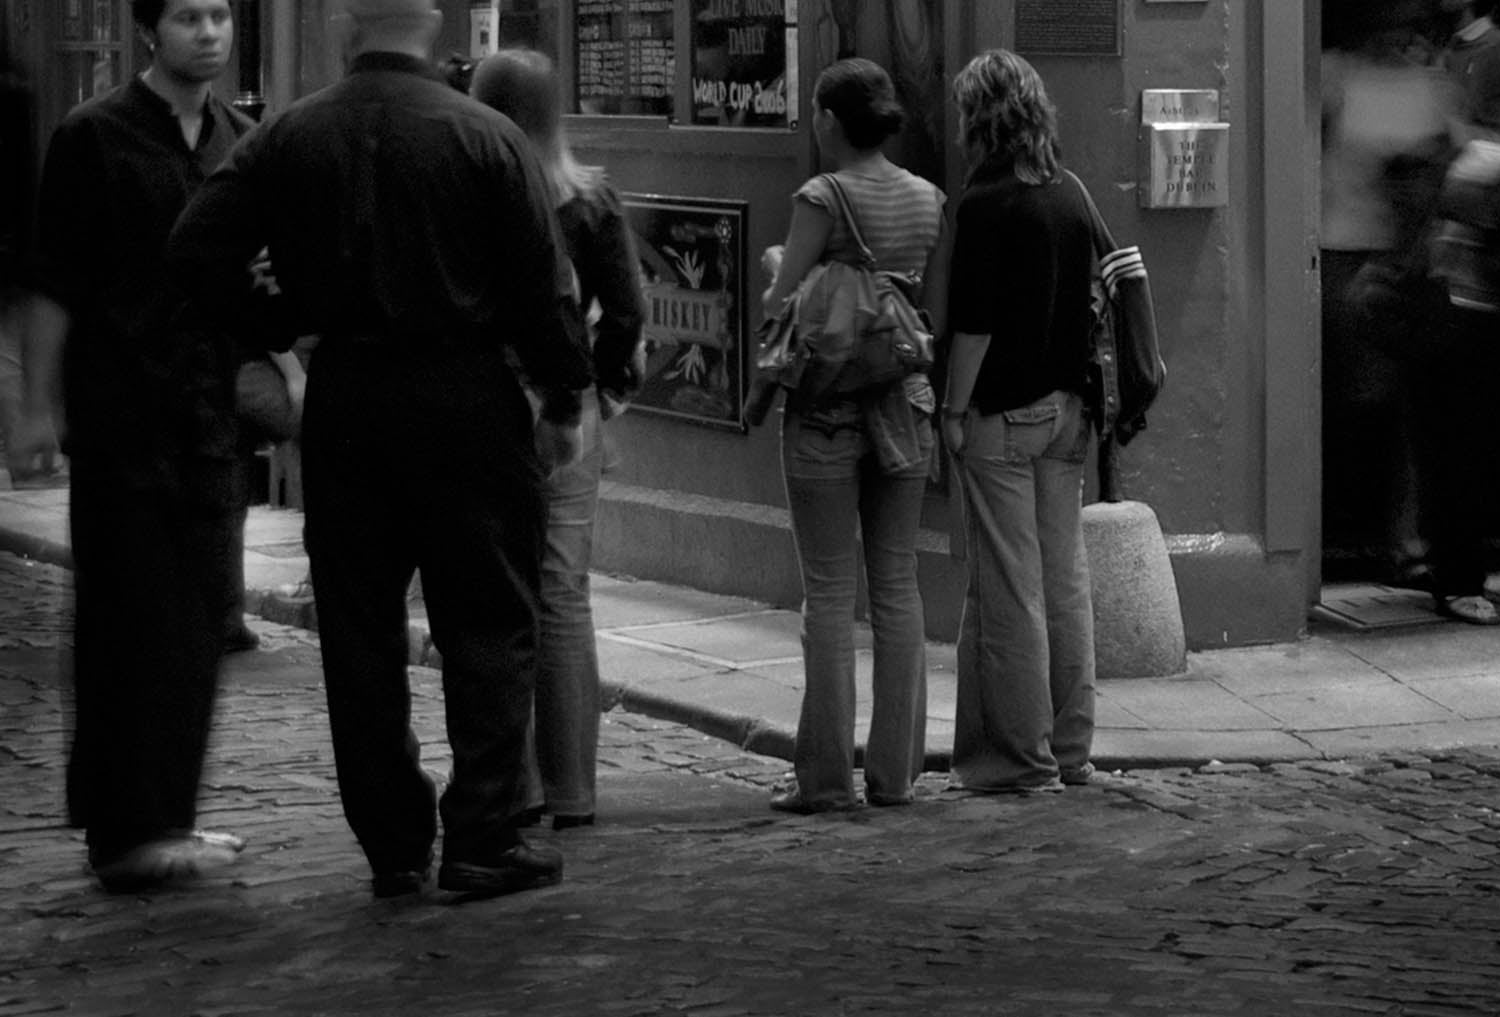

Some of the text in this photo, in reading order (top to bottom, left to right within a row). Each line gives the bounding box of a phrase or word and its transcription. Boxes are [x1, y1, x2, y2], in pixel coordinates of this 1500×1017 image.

[728, 27, 766, 55] DAILY
[693, 77, 727, 107] WORLD
[730, 81, 753, 110] CUP
[652, 296, 712, 332] HISKEY
